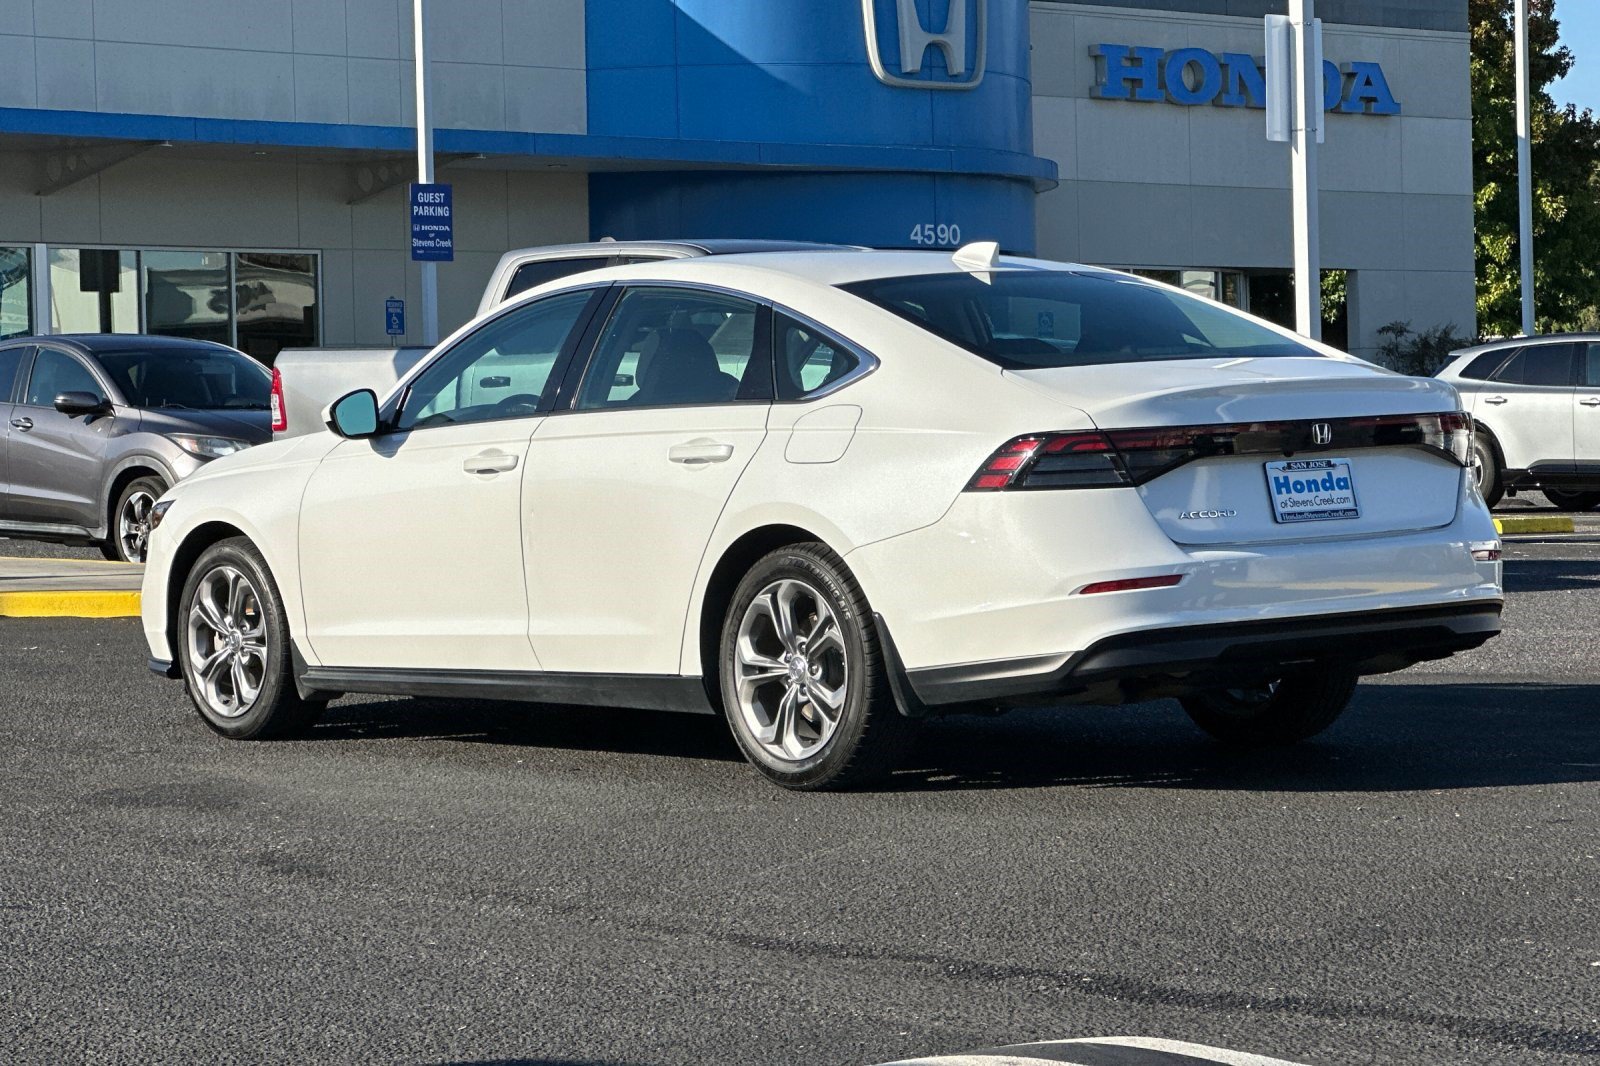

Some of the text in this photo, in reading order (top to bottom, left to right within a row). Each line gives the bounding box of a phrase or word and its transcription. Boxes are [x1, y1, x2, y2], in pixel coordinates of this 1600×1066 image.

[417, 192, 445, 203] GUEST
[413, 206, 450, 217] PARKING
[910, 224, 961, 245] 4590
[412, 238, 452, 247] Stevens Creek
[1273, 471, 1350, 495] Honda
[1179, 510, 1237, 520] ACCORD
